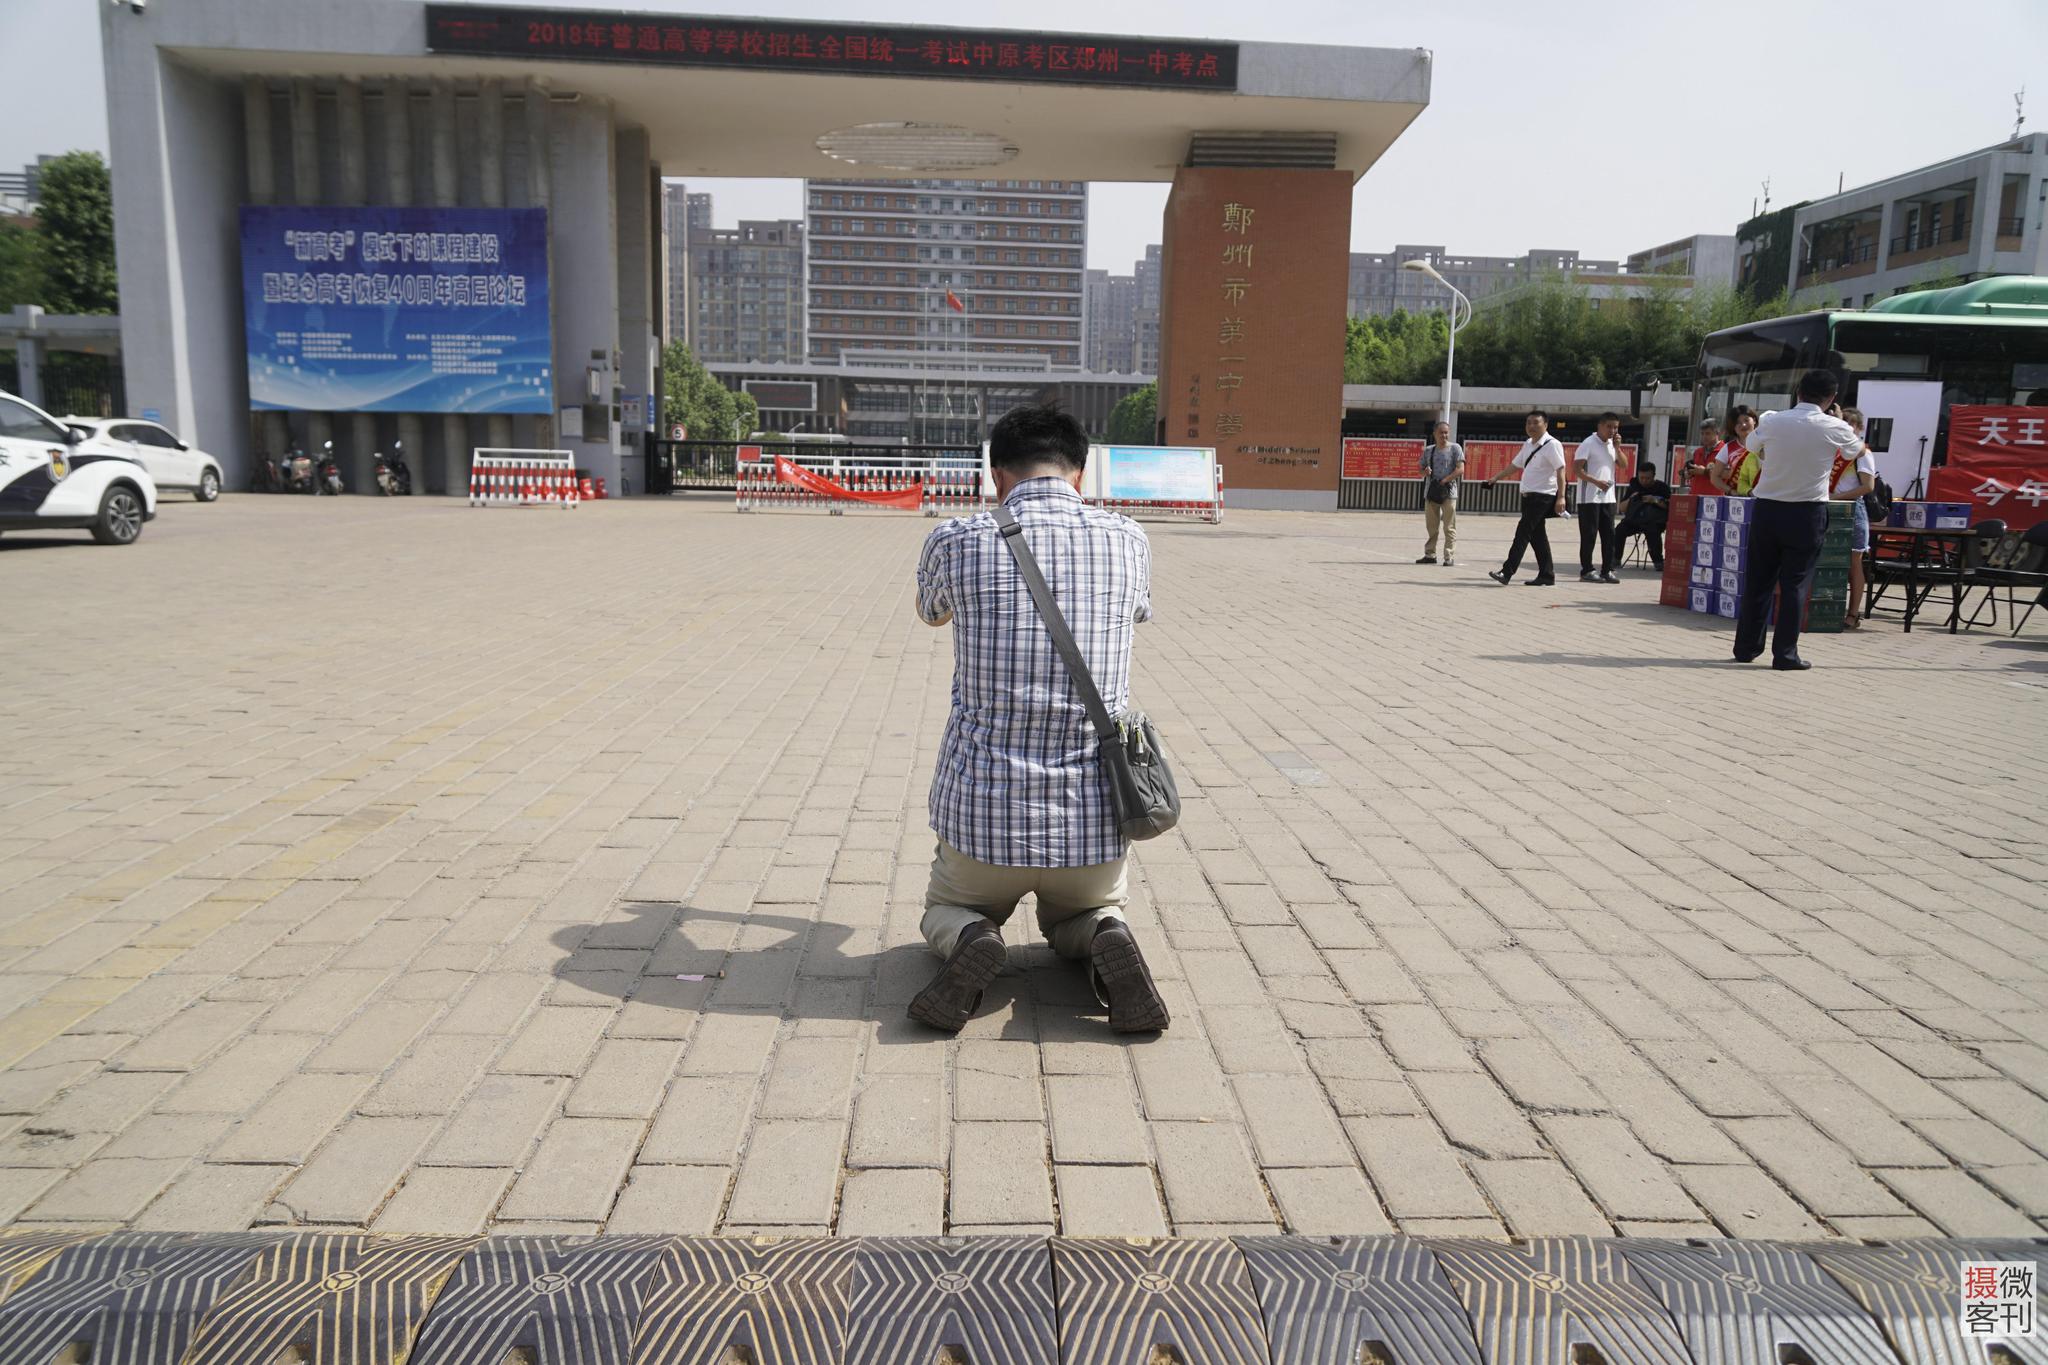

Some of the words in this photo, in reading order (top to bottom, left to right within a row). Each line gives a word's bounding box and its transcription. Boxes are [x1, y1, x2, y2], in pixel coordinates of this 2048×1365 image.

[674, 428, 682, 439] 5
[1977, 417, 2046, 446] 天王
[1970, 477, 2048, 508] 今年
